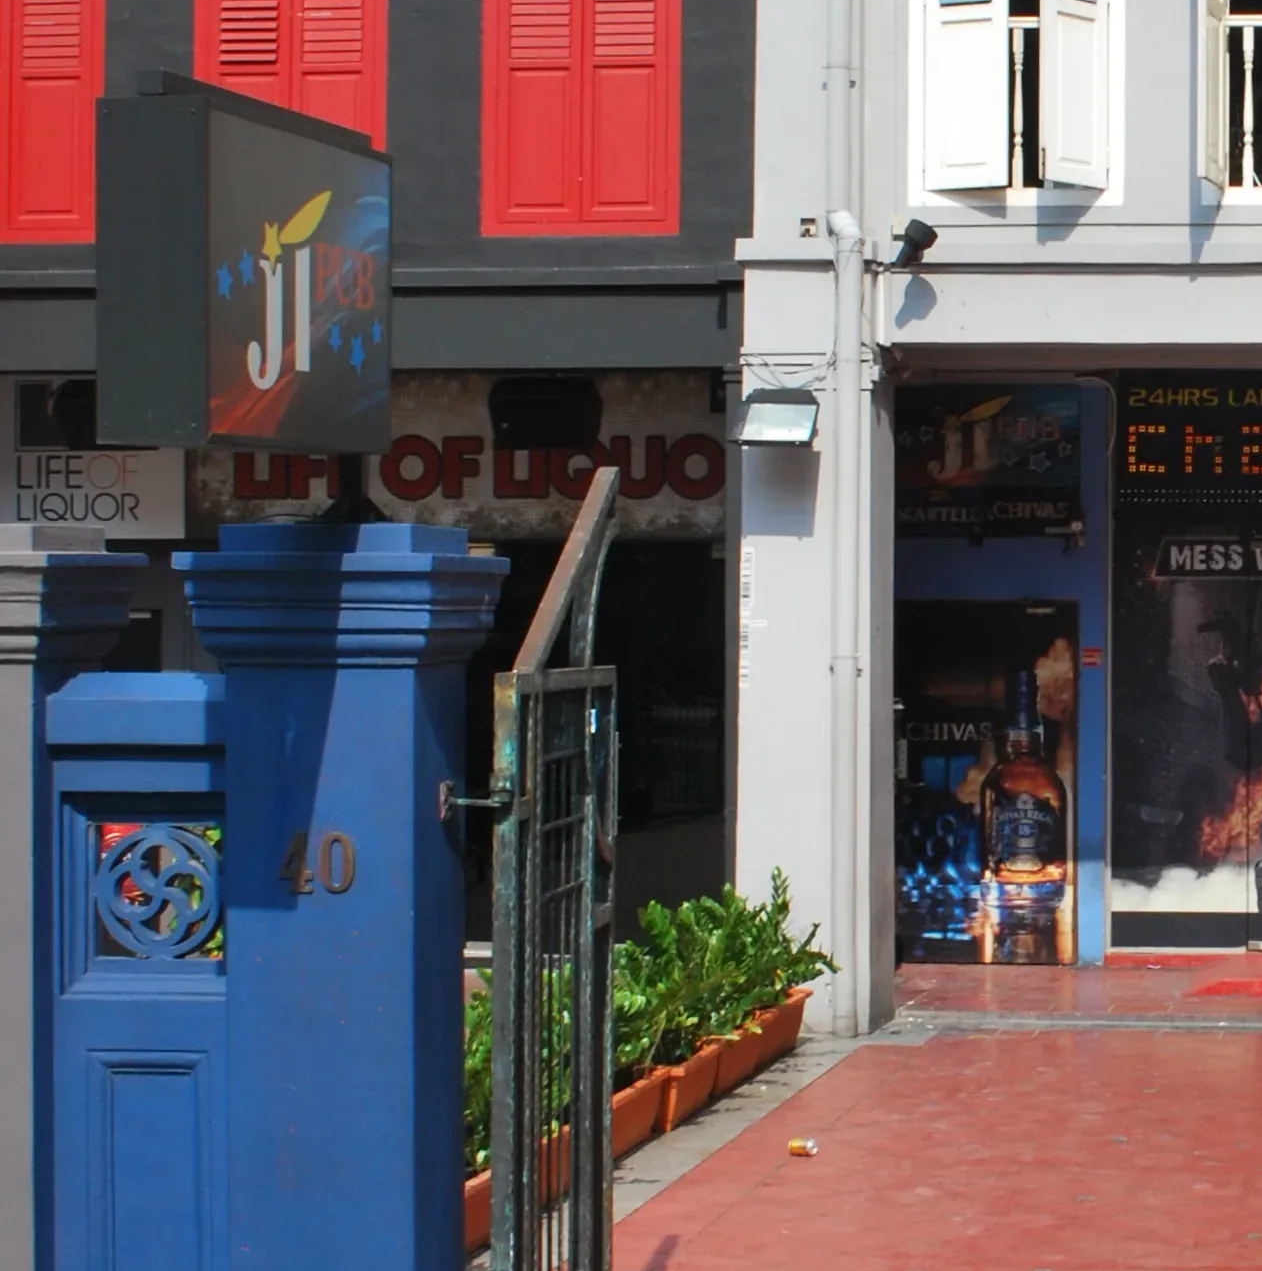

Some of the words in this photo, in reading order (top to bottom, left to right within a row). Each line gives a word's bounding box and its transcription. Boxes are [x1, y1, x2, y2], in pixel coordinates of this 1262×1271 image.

[314, 242, 375, 309] PUB
[1128, 389, 1219, 407] 24HRS
[17, 455, 83, 489] LIFE
[380, 434, 484, 501] OF
[17, 492, 139, 522] LIQUOR
[992, 501, 1069, 519] CHIVAS
[1169, 544, 1244, 571] MESS
[906, 722, 994, 741] CHIVAS
[278, 830, 356, 895] 40
